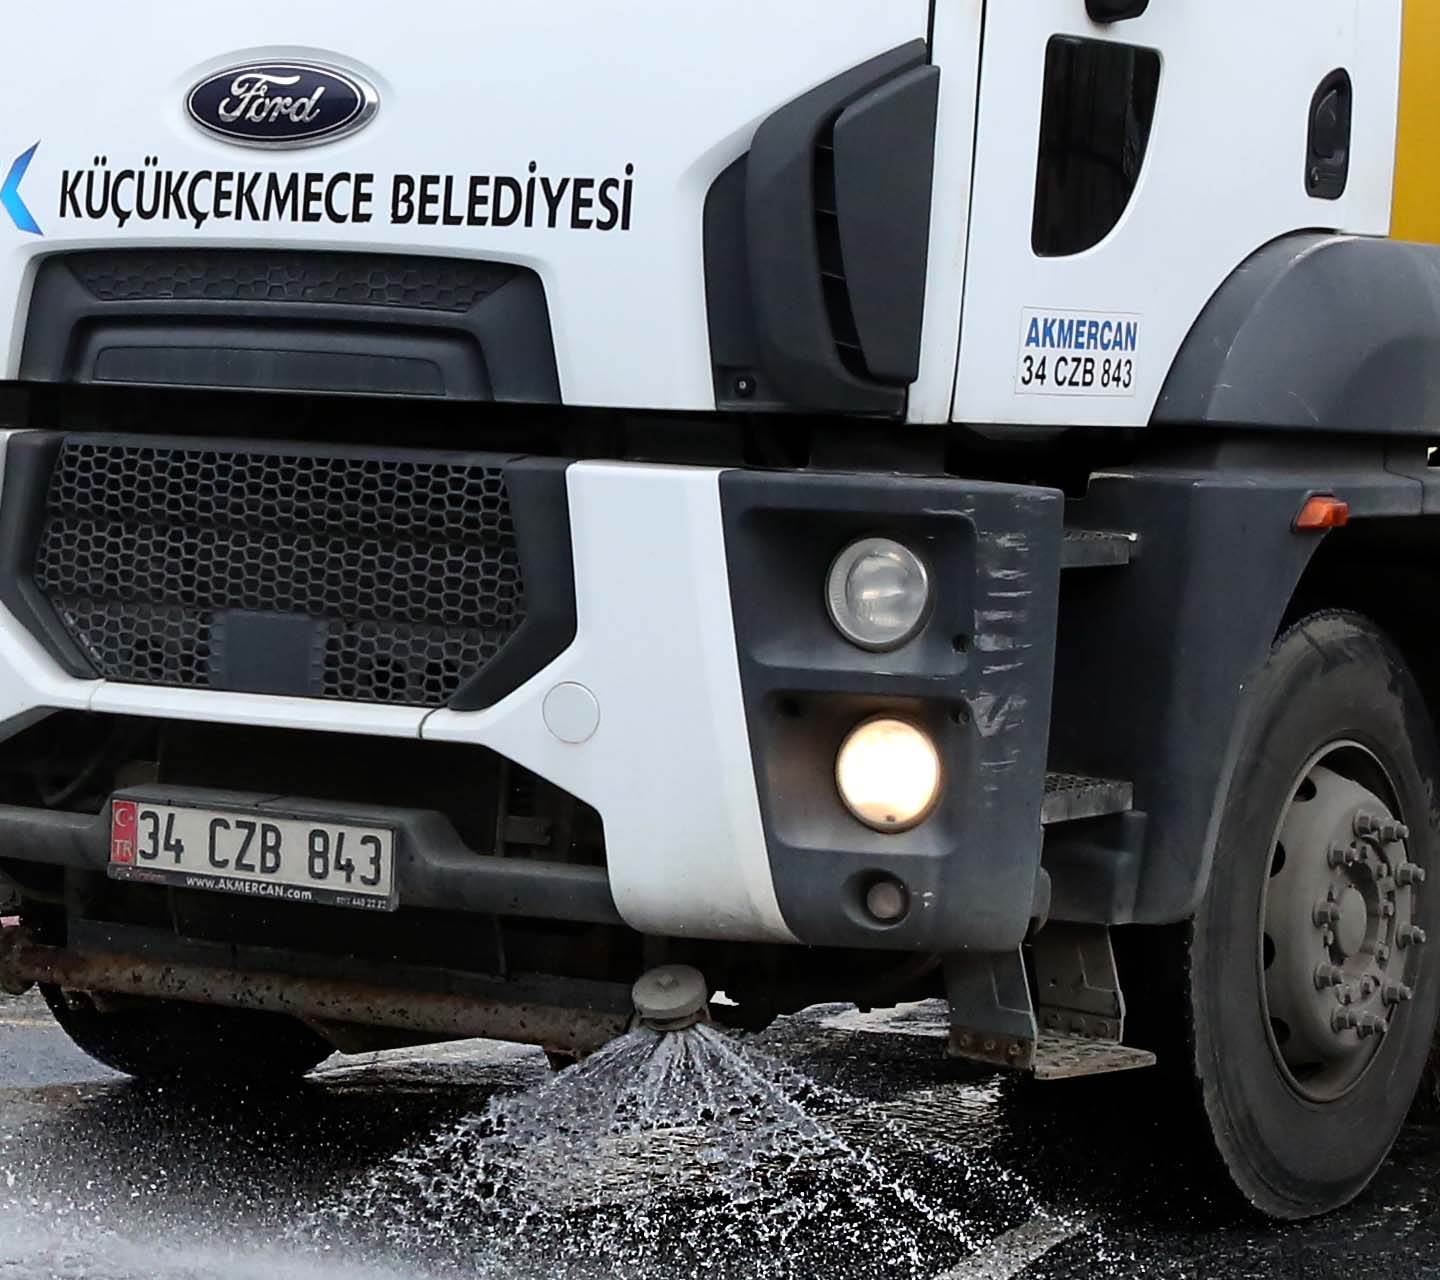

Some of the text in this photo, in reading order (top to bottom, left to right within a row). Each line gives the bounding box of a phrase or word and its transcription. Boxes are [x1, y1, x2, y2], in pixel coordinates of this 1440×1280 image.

[218, 72, 324, 124] Ford
[59, 155, 634, 231] KÜÇÜKÇEKMECE BELEDİYESİ
[1025, 317, 1138, 351] AKMERCAN
[1021, 355, 1132, 388] 34 CZB 843
[113, 838, 132, 858] TR
[138, 810, 382, 886] 34 CZB 843
[185, 876, 312, 901] www.AKMERCAN.com
